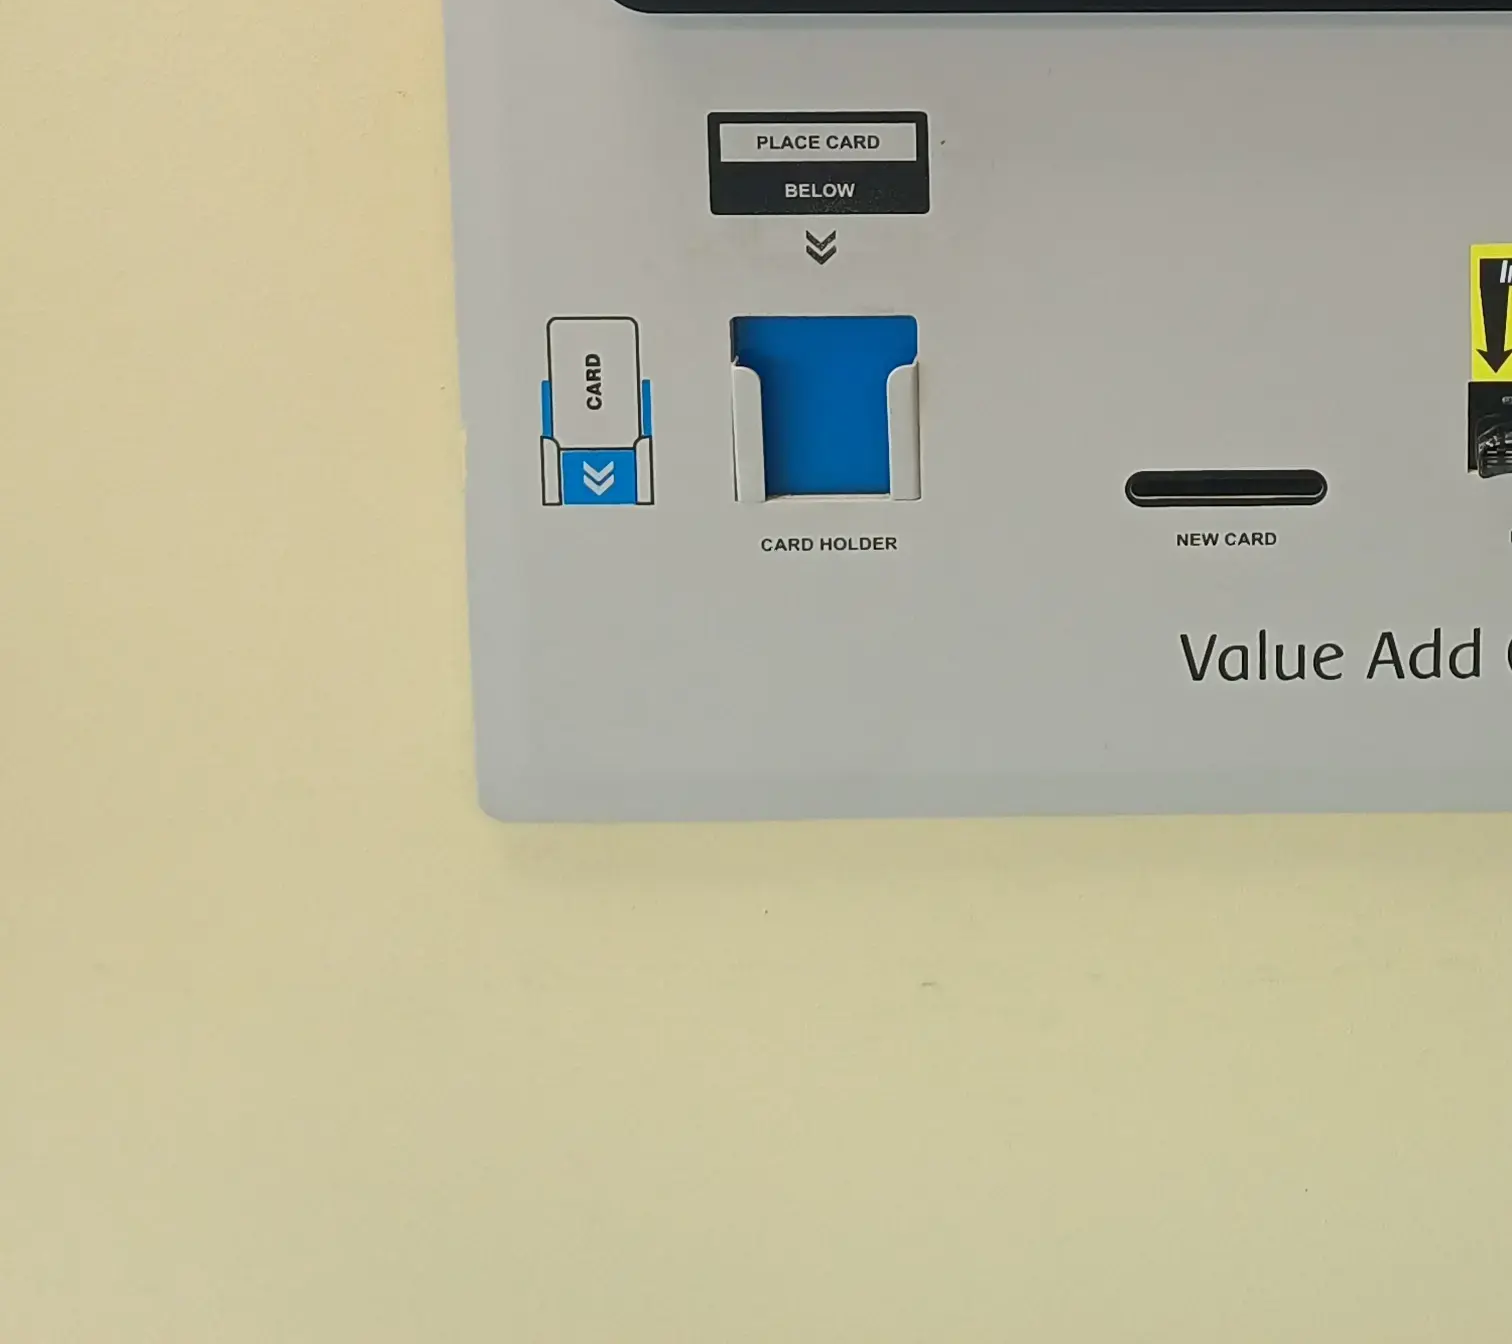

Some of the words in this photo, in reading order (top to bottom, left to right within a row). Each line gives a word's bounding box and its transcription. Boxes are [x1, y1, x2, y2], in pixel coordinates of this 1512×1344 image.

[756, 135, 820, 150] PLACE
[826, 135, 880, 149] CARD
[784, 183, 855, 198] BELOW
[585, 353, 602, 411] CARD
[760, 537, 814, 552] CARD
[820, 536, 898, 551] HOLDER
[1176, 531, 1221, 547] NEW
[1225, 531, 1278, 546] CARD
[1179, 629, 1345, 683] Value
[1365, 628, 1483, 681] Add
